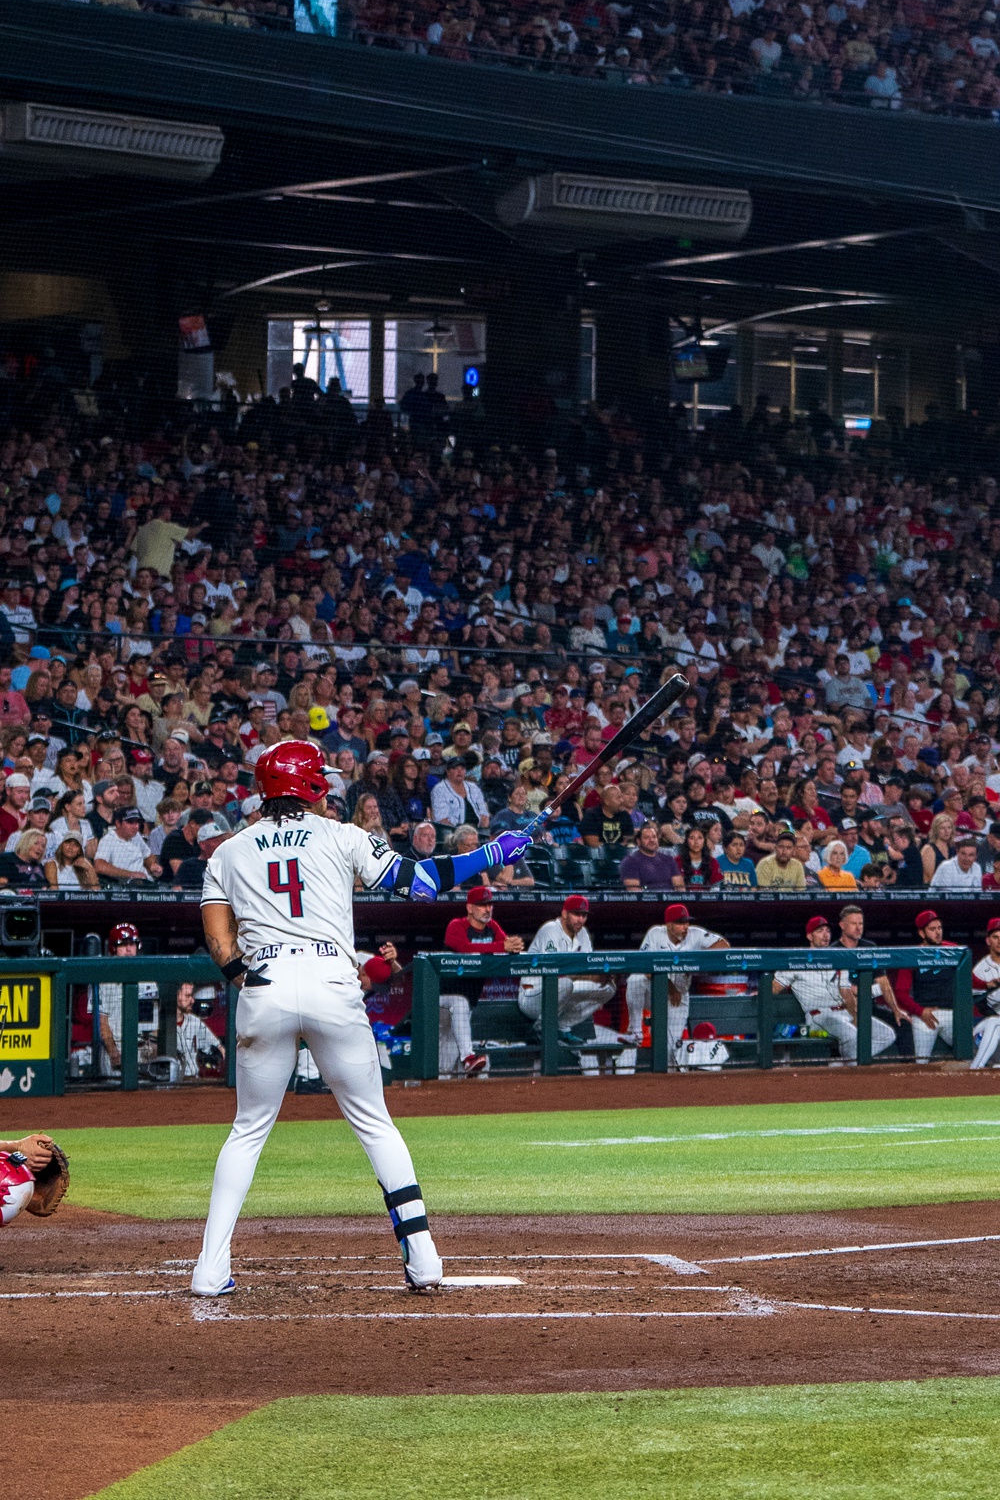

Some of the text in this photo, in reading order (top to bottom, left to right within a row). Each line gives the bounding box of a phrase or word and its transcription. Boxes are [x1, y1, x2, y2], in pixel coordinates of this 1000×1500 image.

[254, 829, 313, 851] MARTE
[267, 856, 305, 919] 4
[70, 893, 88, 901] Banner
[89, 893, 106, 901] Health
[142, 893, 160, 901] Banner
[160, 893, 177, 901] Health
[2, 1034, 32, 1049] FIRM
